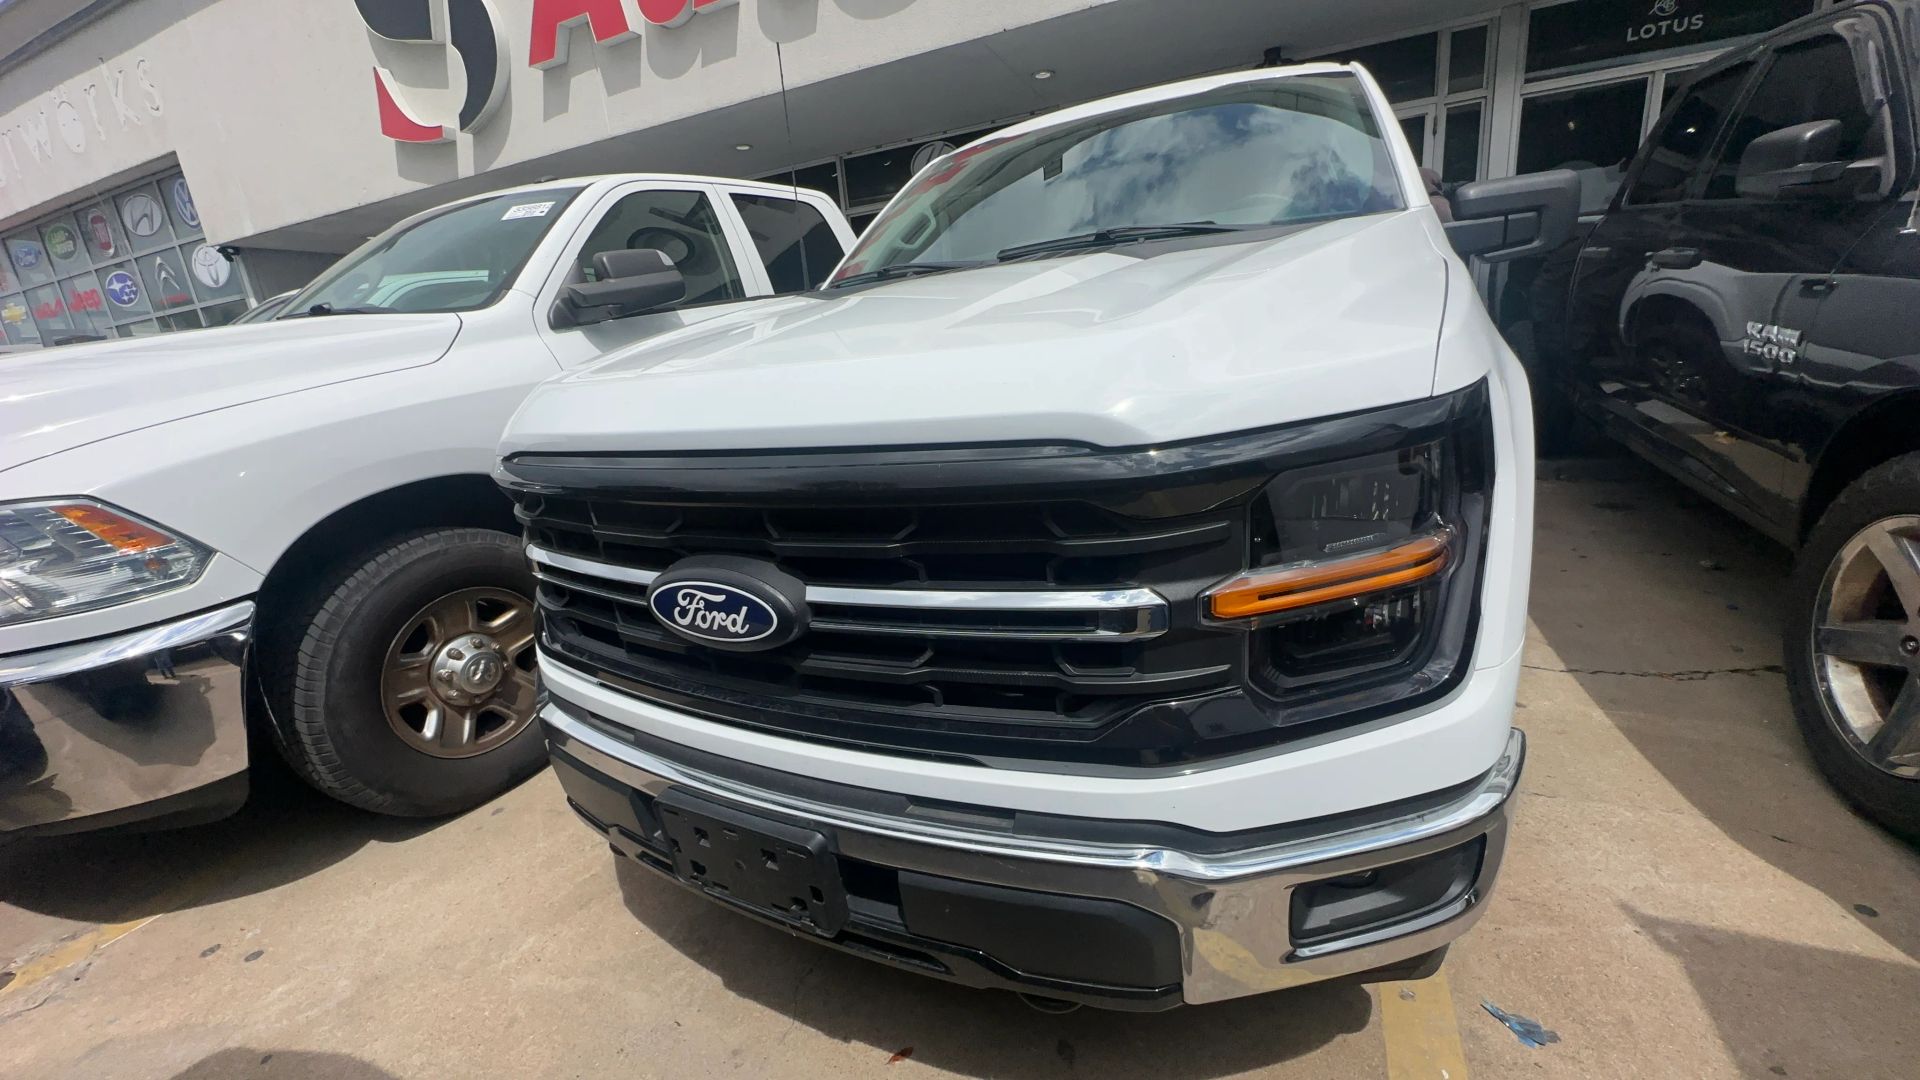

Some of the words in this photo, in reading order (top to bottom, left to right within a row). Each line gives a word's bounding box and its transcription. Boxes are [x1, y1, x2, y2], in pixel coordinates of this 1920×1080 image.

[1626, 14, 1704, 42] LOTUS
[1746, 320, 1802, 347] RAM
[1743, 338, 1797, 364] 1500
[673, 588, 750, 635] Ford
